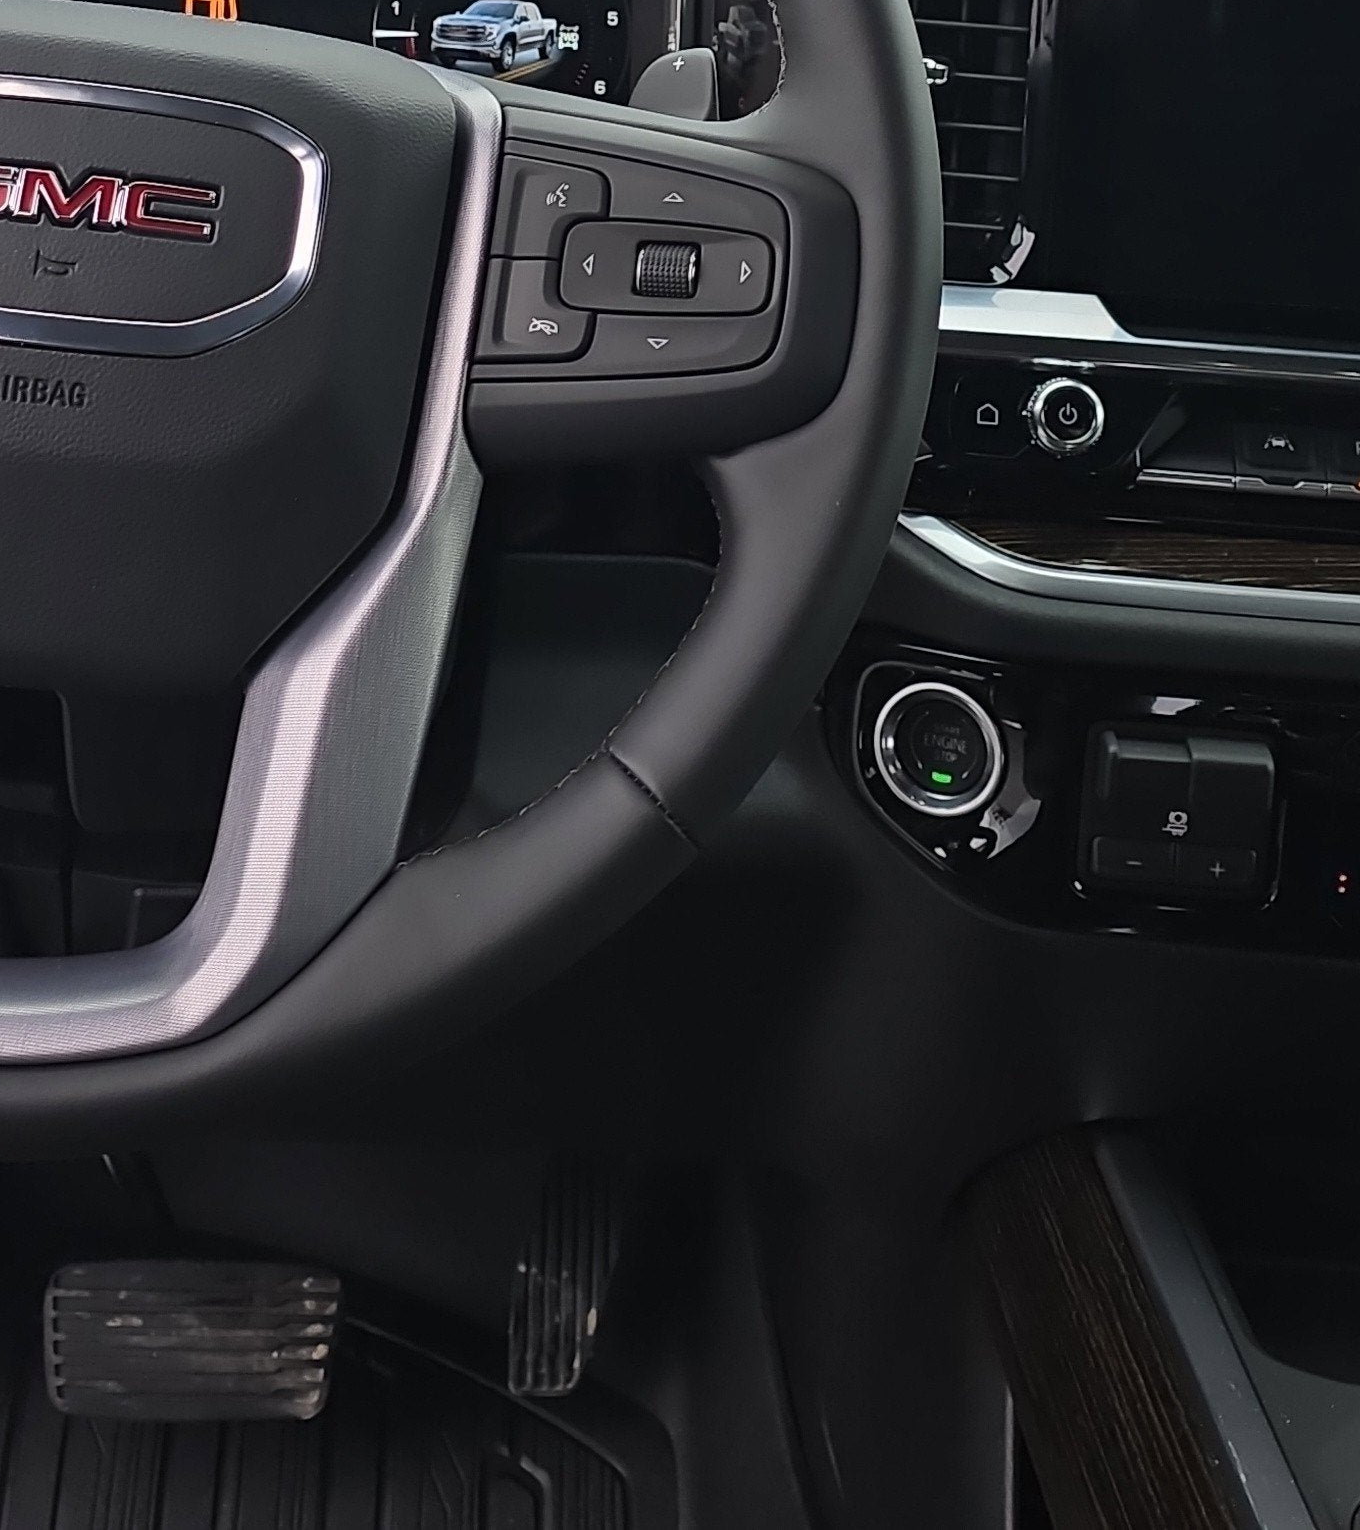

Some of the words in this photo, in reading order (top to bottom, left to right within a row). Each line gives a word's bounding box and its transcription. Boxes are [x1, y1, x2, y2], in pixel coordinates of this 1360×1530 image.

[390, 0, 401, 16] 1
[606, 10, 619, 27] 5
[593, 80, 606, 95] 6
